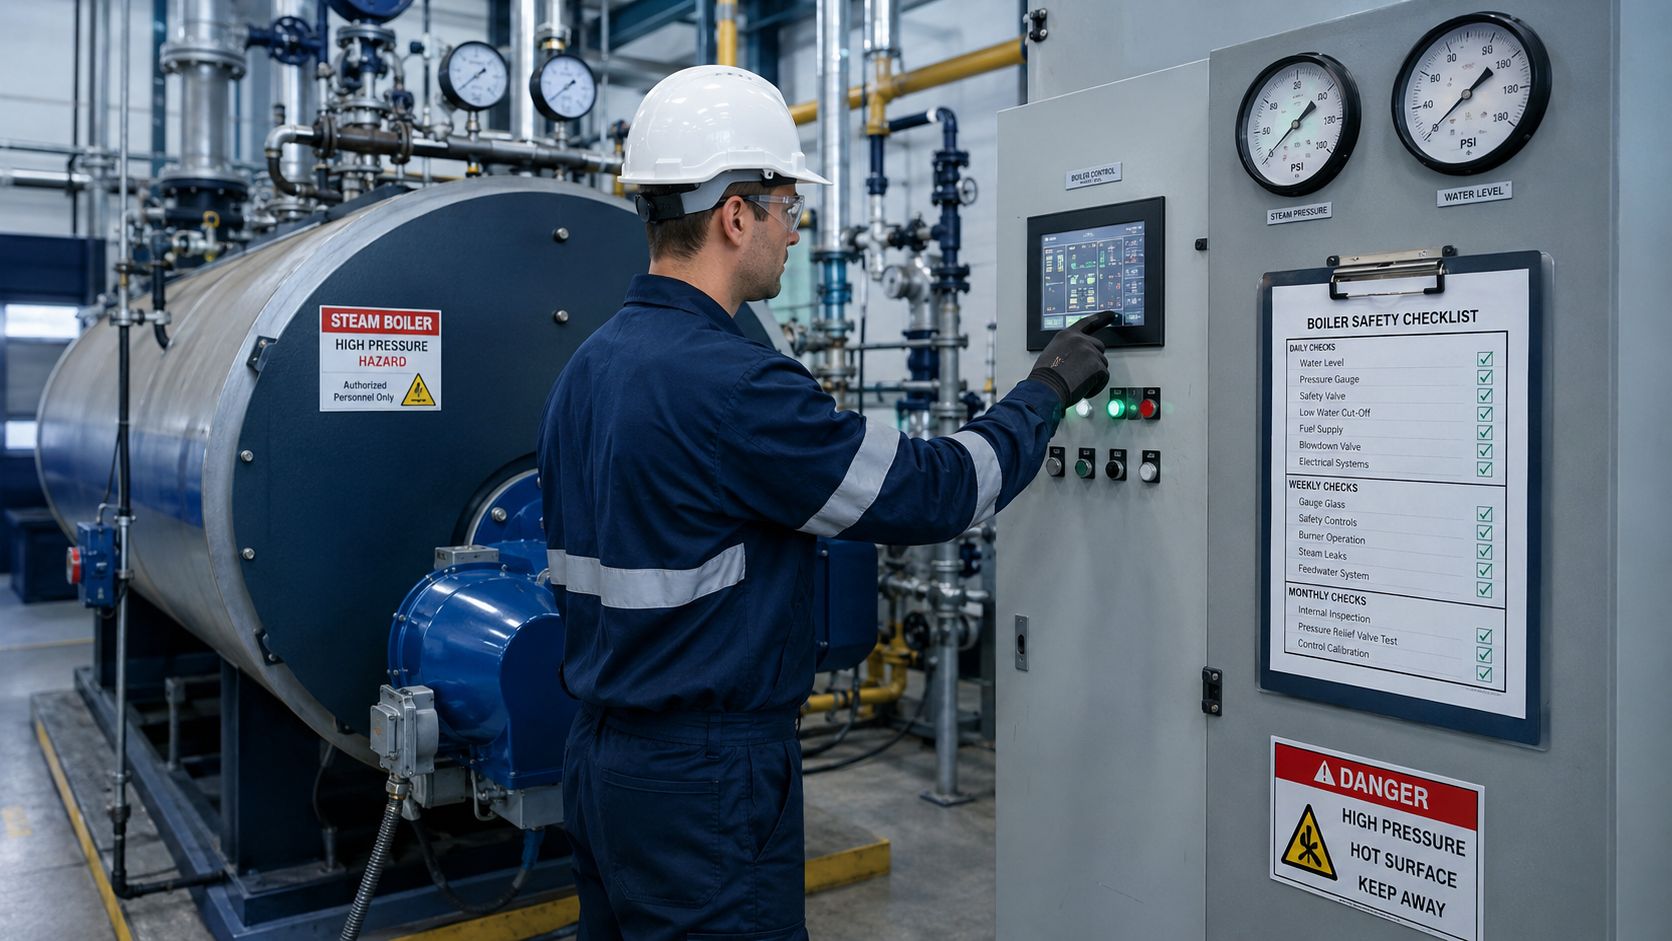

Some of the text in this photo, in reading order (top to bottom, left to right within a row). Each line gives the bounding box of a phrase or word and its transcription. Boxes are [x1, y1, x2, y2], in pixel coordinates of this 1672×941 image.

[1460, 138, 1476, 149] PSI
[1291, 162, 1304, 172] PSI
[1444, 187, 1504, 201] WATER LEVEL
[1270, 206, 1328, 221] STEAM PRESSURE
[331, 313, 432, 330] STEAM BOILER
[1307, 310, 1479, 330] BOILER SAFETY CHECKLIST
[336, 339, 428, 352] HIGH PRESSURE
[1289, 343, 1335, 352] DAILY CHECKS
[359, 356, 406, 367] HAZARD
[1300, 358, 1344, 367] Water Level
[344, 381, 387, 389] Authorized
[1300, 375, 1360, 384] Pressure Gauge
[334, 393, 394, 403] Personnel Only
[1300, 392, 1346, 401] Safety Valve
[1300, 408, 1370, 417] Low Water Cut-Off
[1300, 425, 1343, 435] Fuel Supply
[1299, 441, 1361, 451] Blowdown Valve
[1299, 458, 1369, 470] Electrical Systems
[1289, 480, 1358, 492] WEEKLY CHECKS
[1299, 498, 1345, 509] Gauge Glass
[1299, 514, 1357, 527] Safety Controls
[1299, 531, 1366, 545] Burner Operation
[1299, 547, 1347, 560] Steam Leaks
[1299, 564, 1369, 581] Feedwater System
[1289, 588, 1366, 606] MONTHLY CHECKS
[1299, 606, 1371, 623] Internal Inspection
[1298, 623, 1398, 645] Pressure Relief Valve Test
[1298, 639, 1369, 658] Control Calibration
[1340, 766, 1429, 810] DANGER
[1343, 808, 1466, 857] HIGH PRESSURE
[1351, 842, 1457, 888] HOT SURFACE
[1359, 876, 1396, 901] KEEP
[1401, 891, 1446, 918] AWAY
